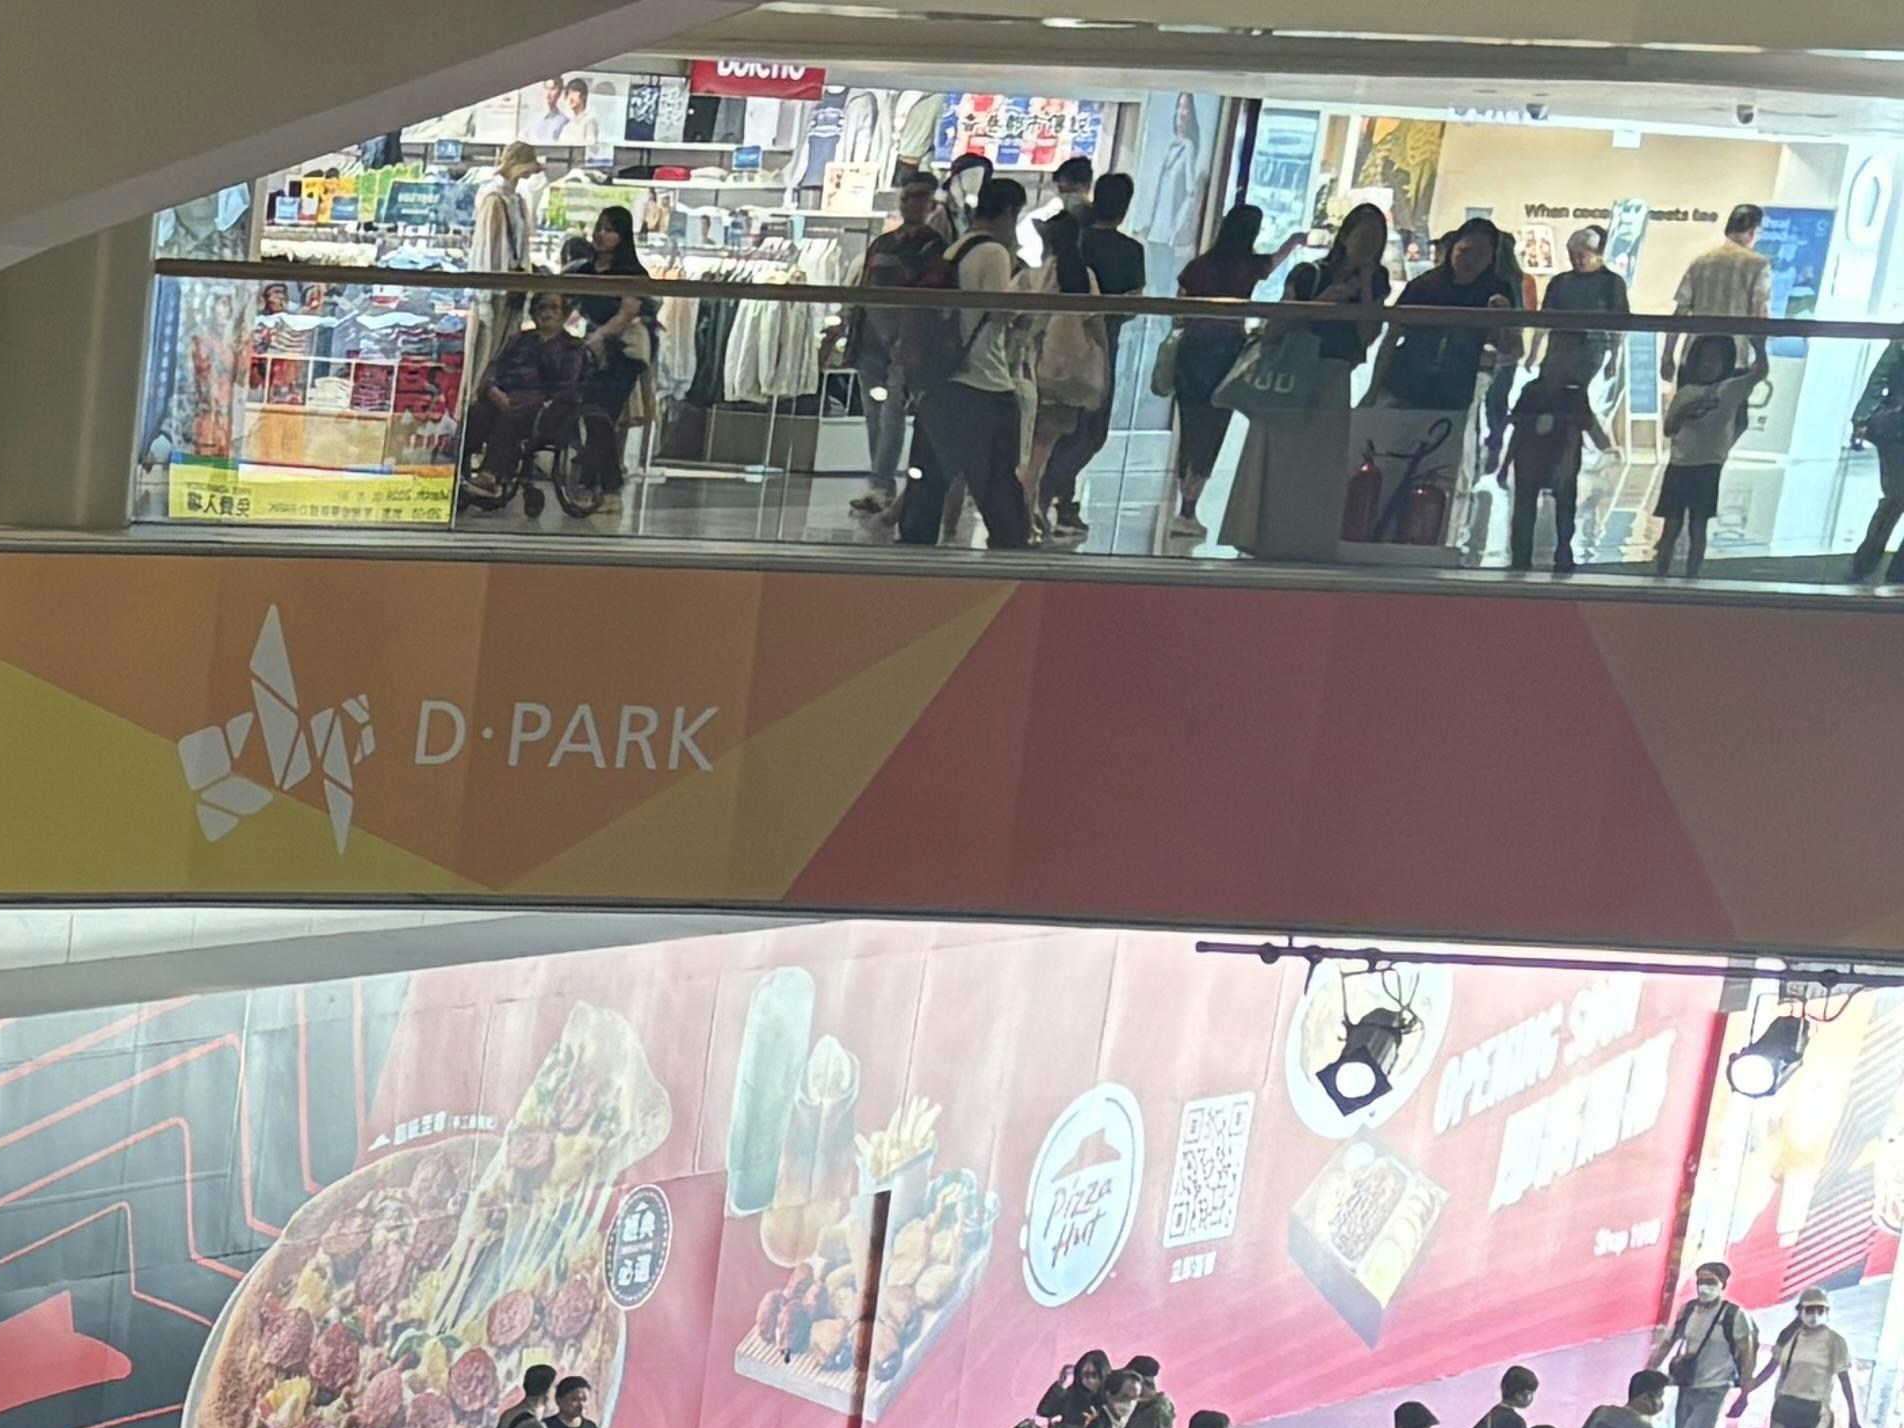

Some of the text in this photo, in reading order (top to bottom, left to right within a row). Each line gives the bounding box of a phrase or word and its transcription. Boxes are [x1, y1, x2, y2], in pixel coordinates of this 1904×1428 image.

[1525, 204, 1570, 219] When
[1042, 1176, 1114, 1240] Pizza
[1050, 1211, 1103, 1269] Hut
